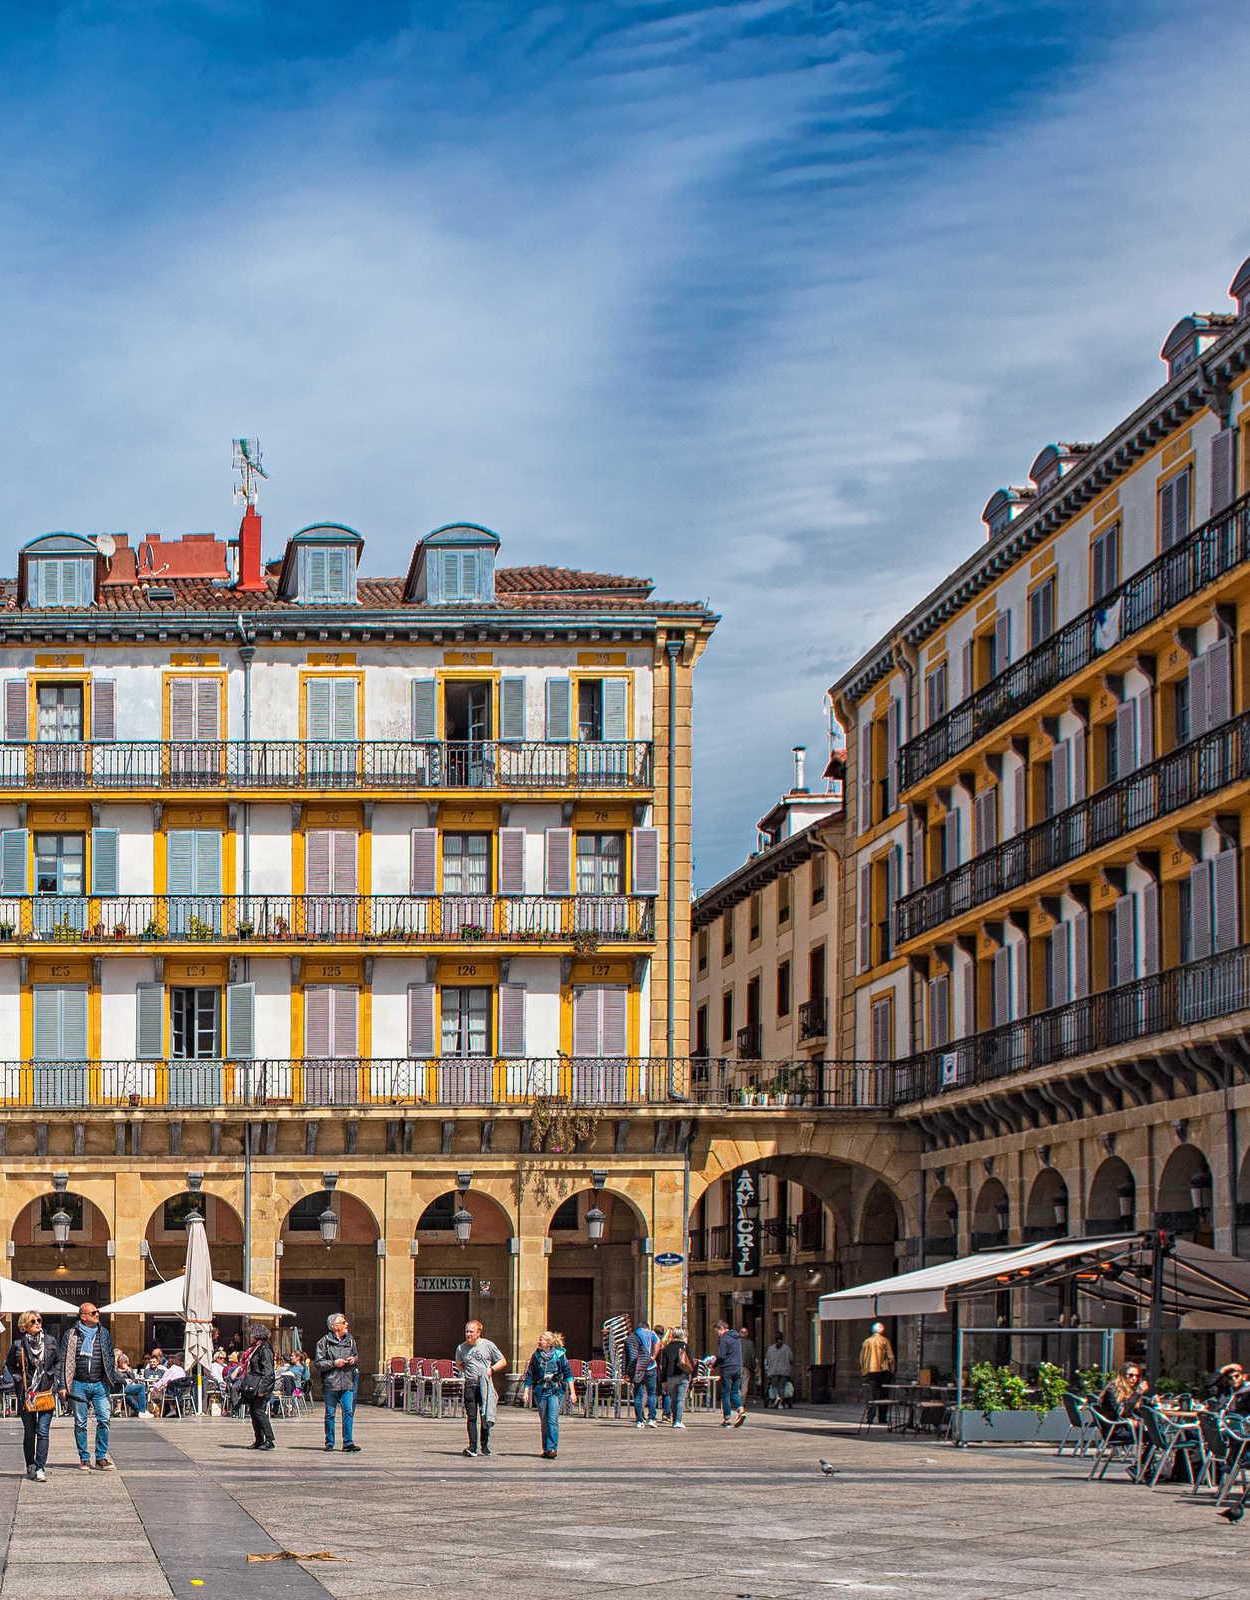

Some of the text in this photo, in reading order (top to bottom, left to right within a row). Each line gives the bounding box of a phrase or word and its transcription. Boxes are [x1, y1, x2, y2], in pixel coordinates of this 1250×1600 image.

[325, 811, 339, 822] 76
[594, 811, 608, 822] 78
[322, 966, 341, 976] 125
[457, 966, 476, 976] 126
[591, 965, 610, 976] 127
